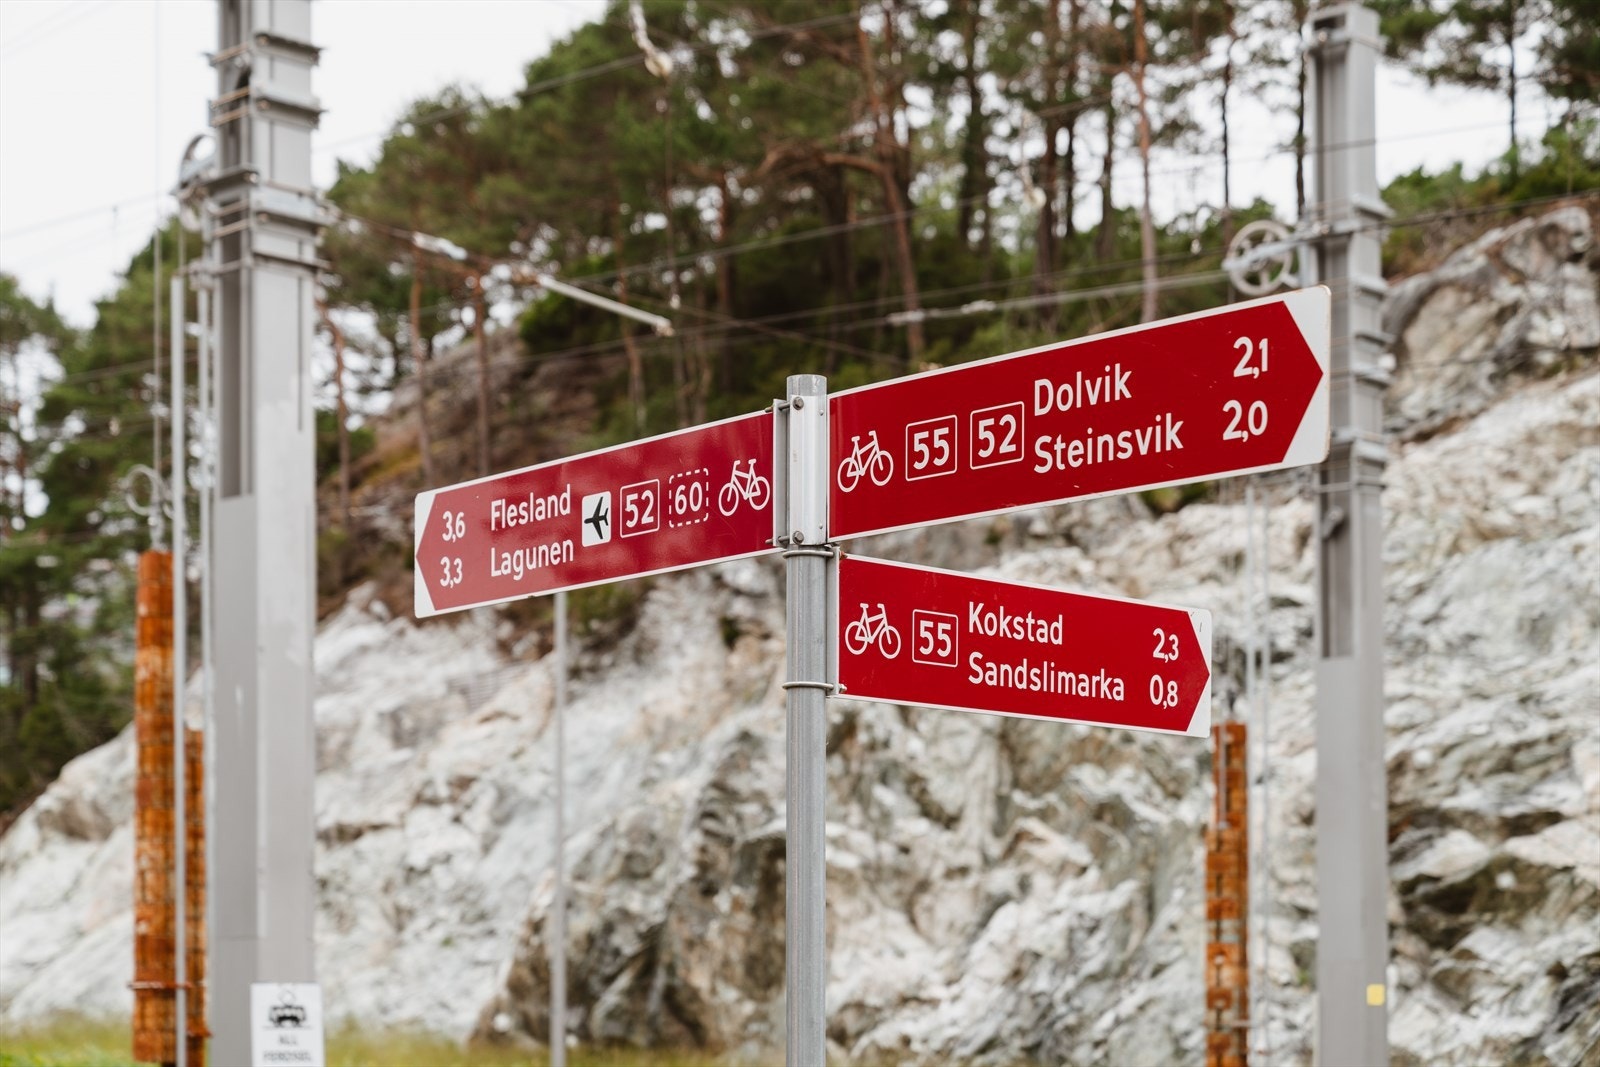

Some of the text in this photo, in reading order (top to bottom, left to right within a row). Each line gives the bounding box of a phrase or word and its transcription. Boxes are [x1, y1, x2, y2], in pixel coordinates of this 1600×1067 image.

[1034, 337, 1268, 416] Dolvik 2,1
[914, 414, 1016, 471] 55 52
[1034, 400, 1268, 473] Steinsvik 2,0
[442, 484, 571, 543] 3,6 Flesland
[625, 482, 703, 528] 52 60
[440, 540, 574, 589] 3,3 Lagunen
[919, 620, 952, 658] 55
[968, 602, 1179, 663] Kokstad 2,3
[968, 652, 1179, 709] Sandslimarka 0,8
